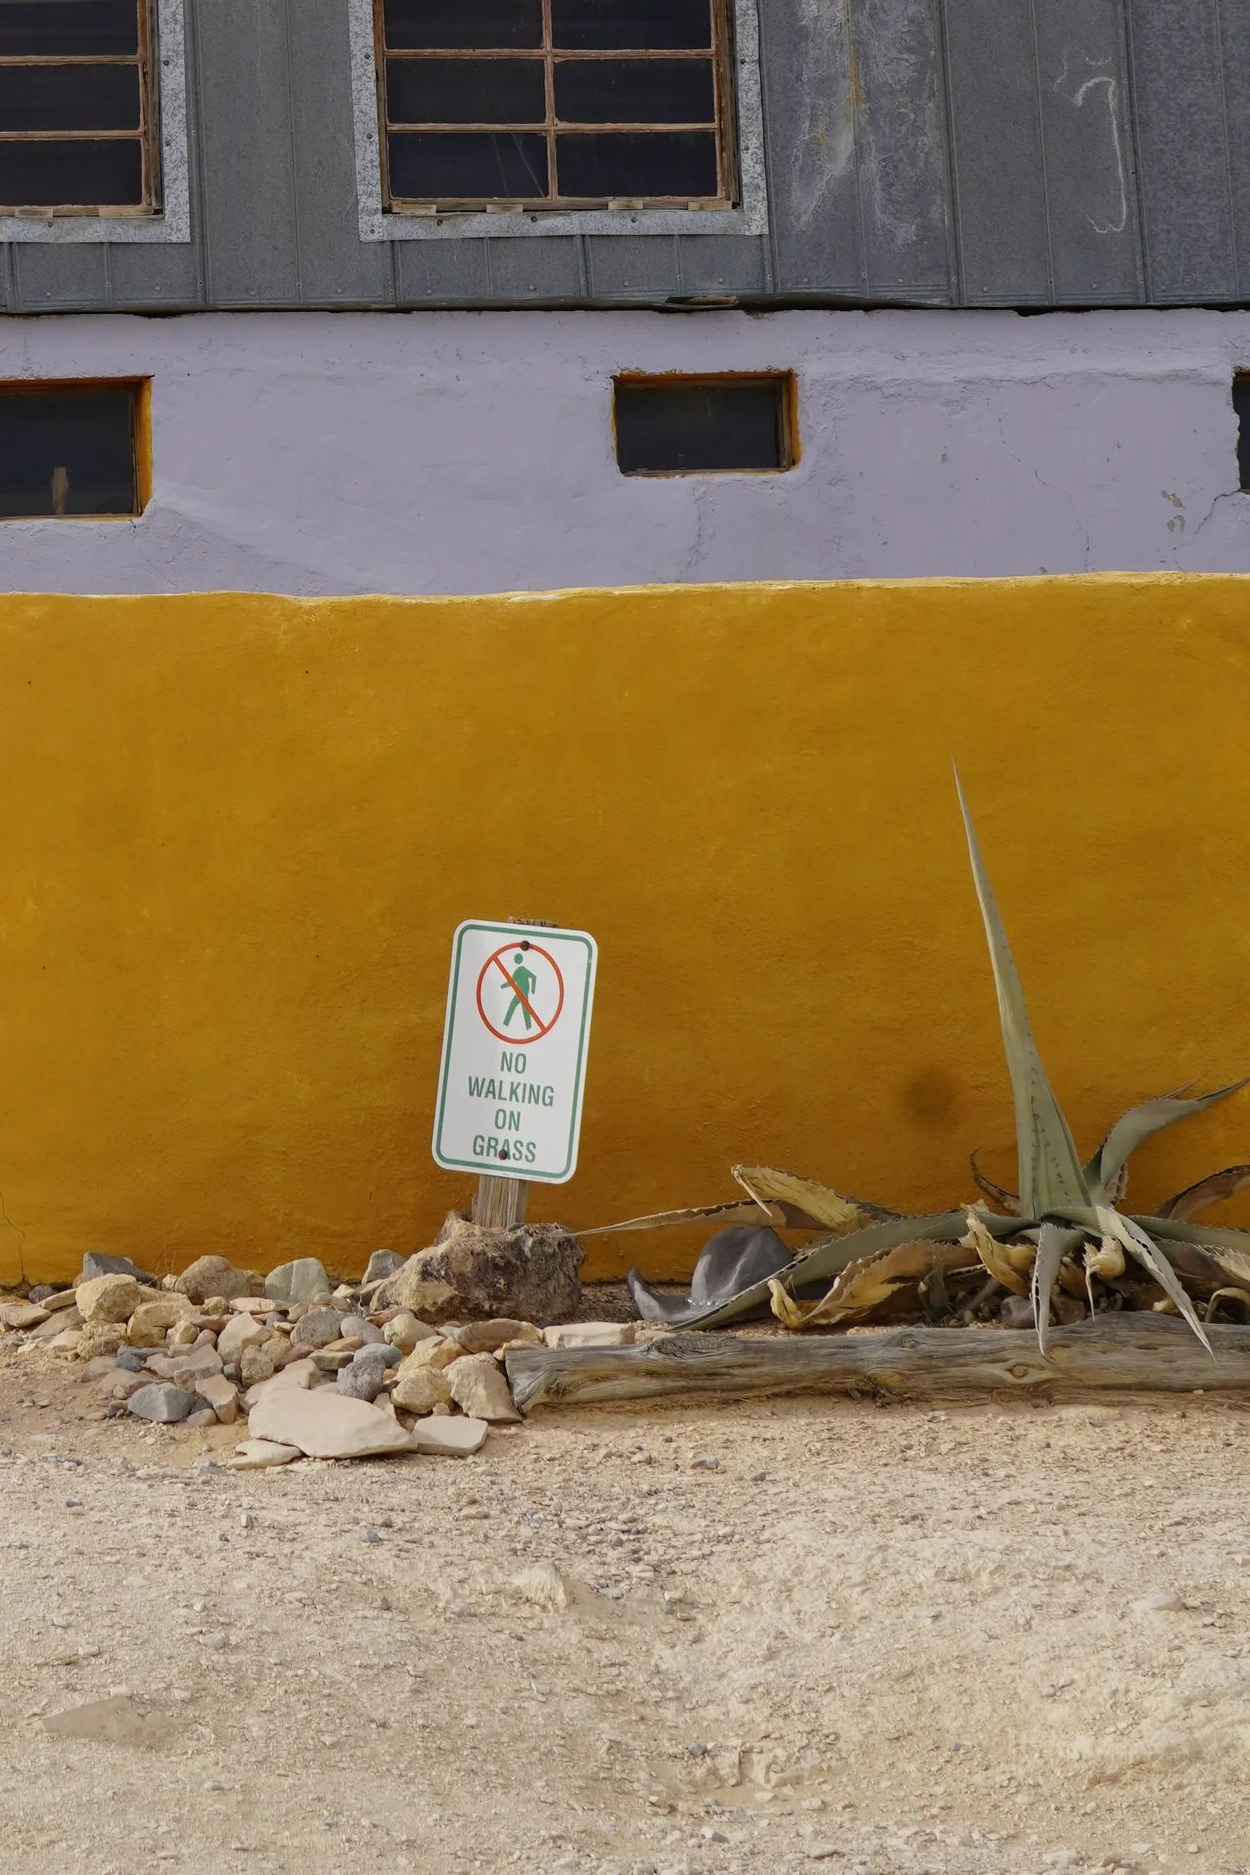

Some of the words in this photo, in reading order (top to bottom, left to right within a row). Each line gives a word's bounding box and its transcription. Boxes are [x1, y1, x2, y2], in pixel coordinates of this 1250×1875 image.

[500, 1051, 527, 1074] NO
[468, 1076, 554, 1107] WALKING
[494, 1108, 521, 1132] ON
[472, 1134, 536, 1163] GRASS
